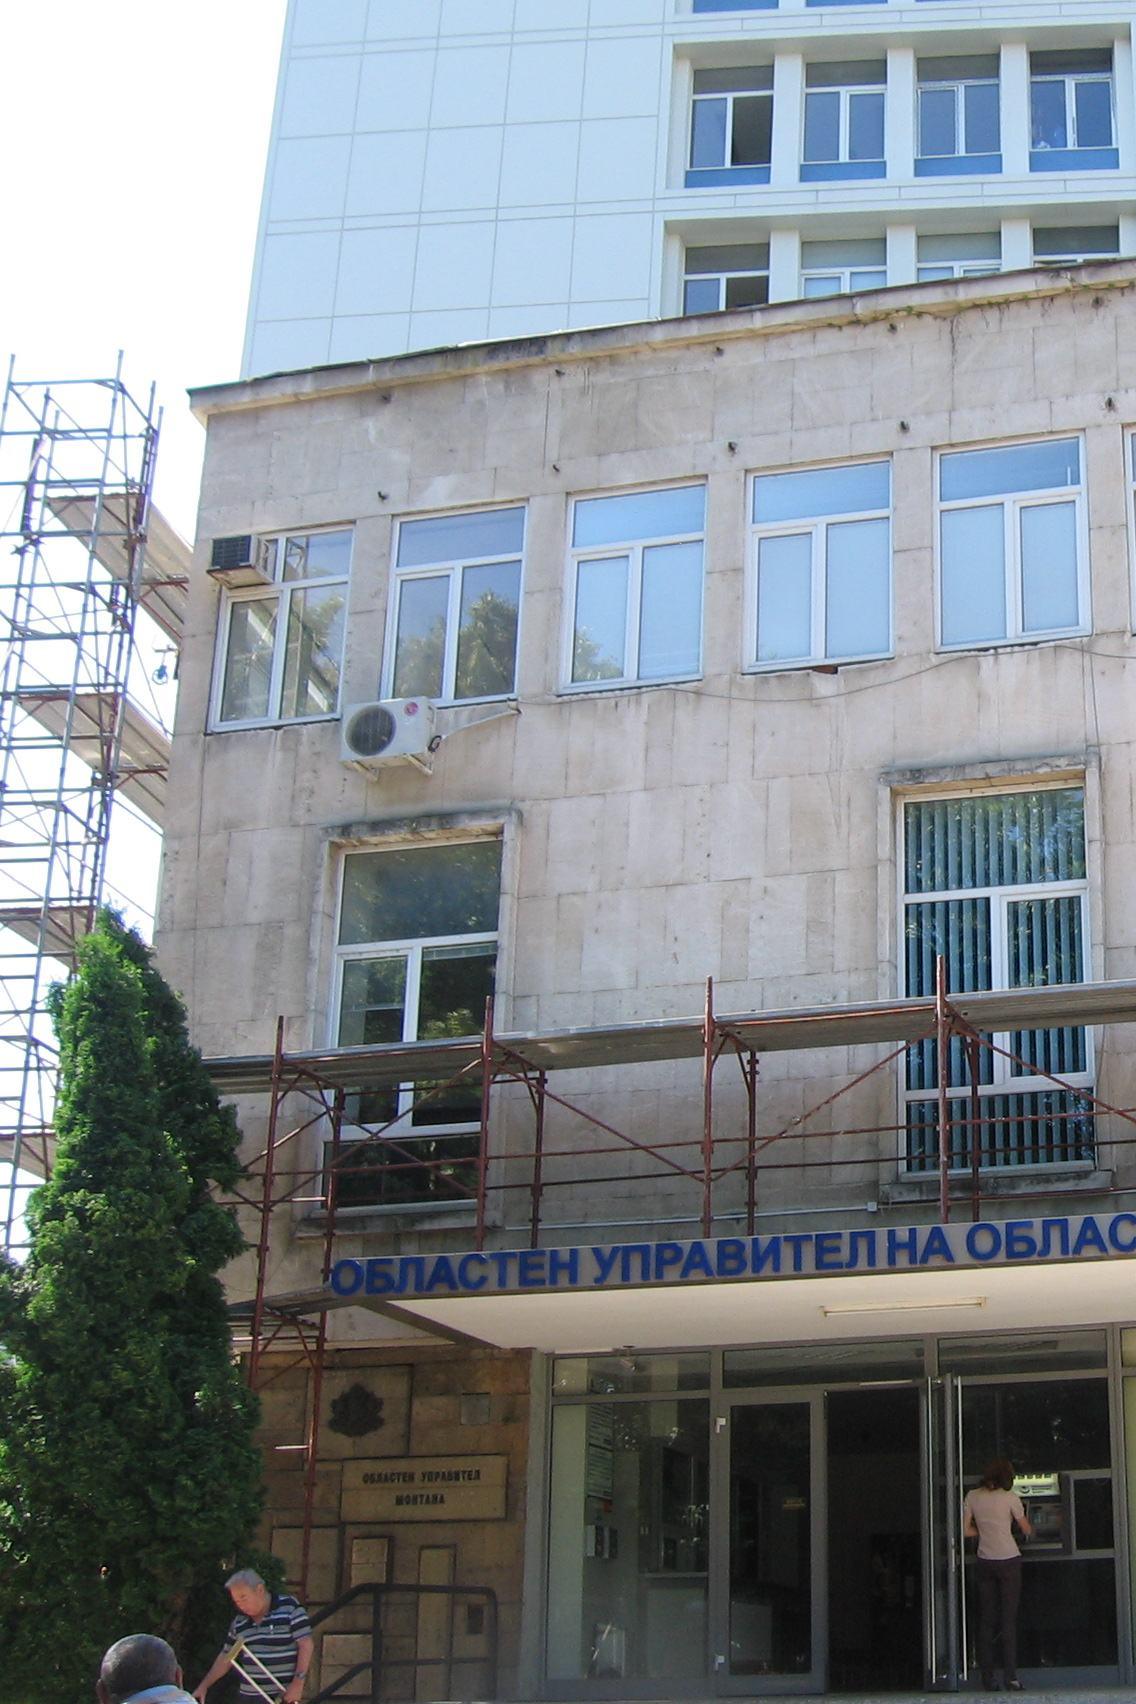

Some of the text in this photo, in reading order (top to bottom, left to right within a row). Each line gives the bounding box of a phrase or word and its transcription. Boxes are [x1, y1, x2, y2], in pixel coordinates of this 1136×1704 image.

[331, 1248, 580, 1296] ОБЛАСТЕН
[592, 1230, 877, 1284] УПРАВИТЕЛ
[887, 1226, 954, 1265] НА
[362, 1469, 481, 1484] ОБЛАСТЕН УПРАВИТЕЛ
[395, 1493, 446, 1506] МОНТАНА
